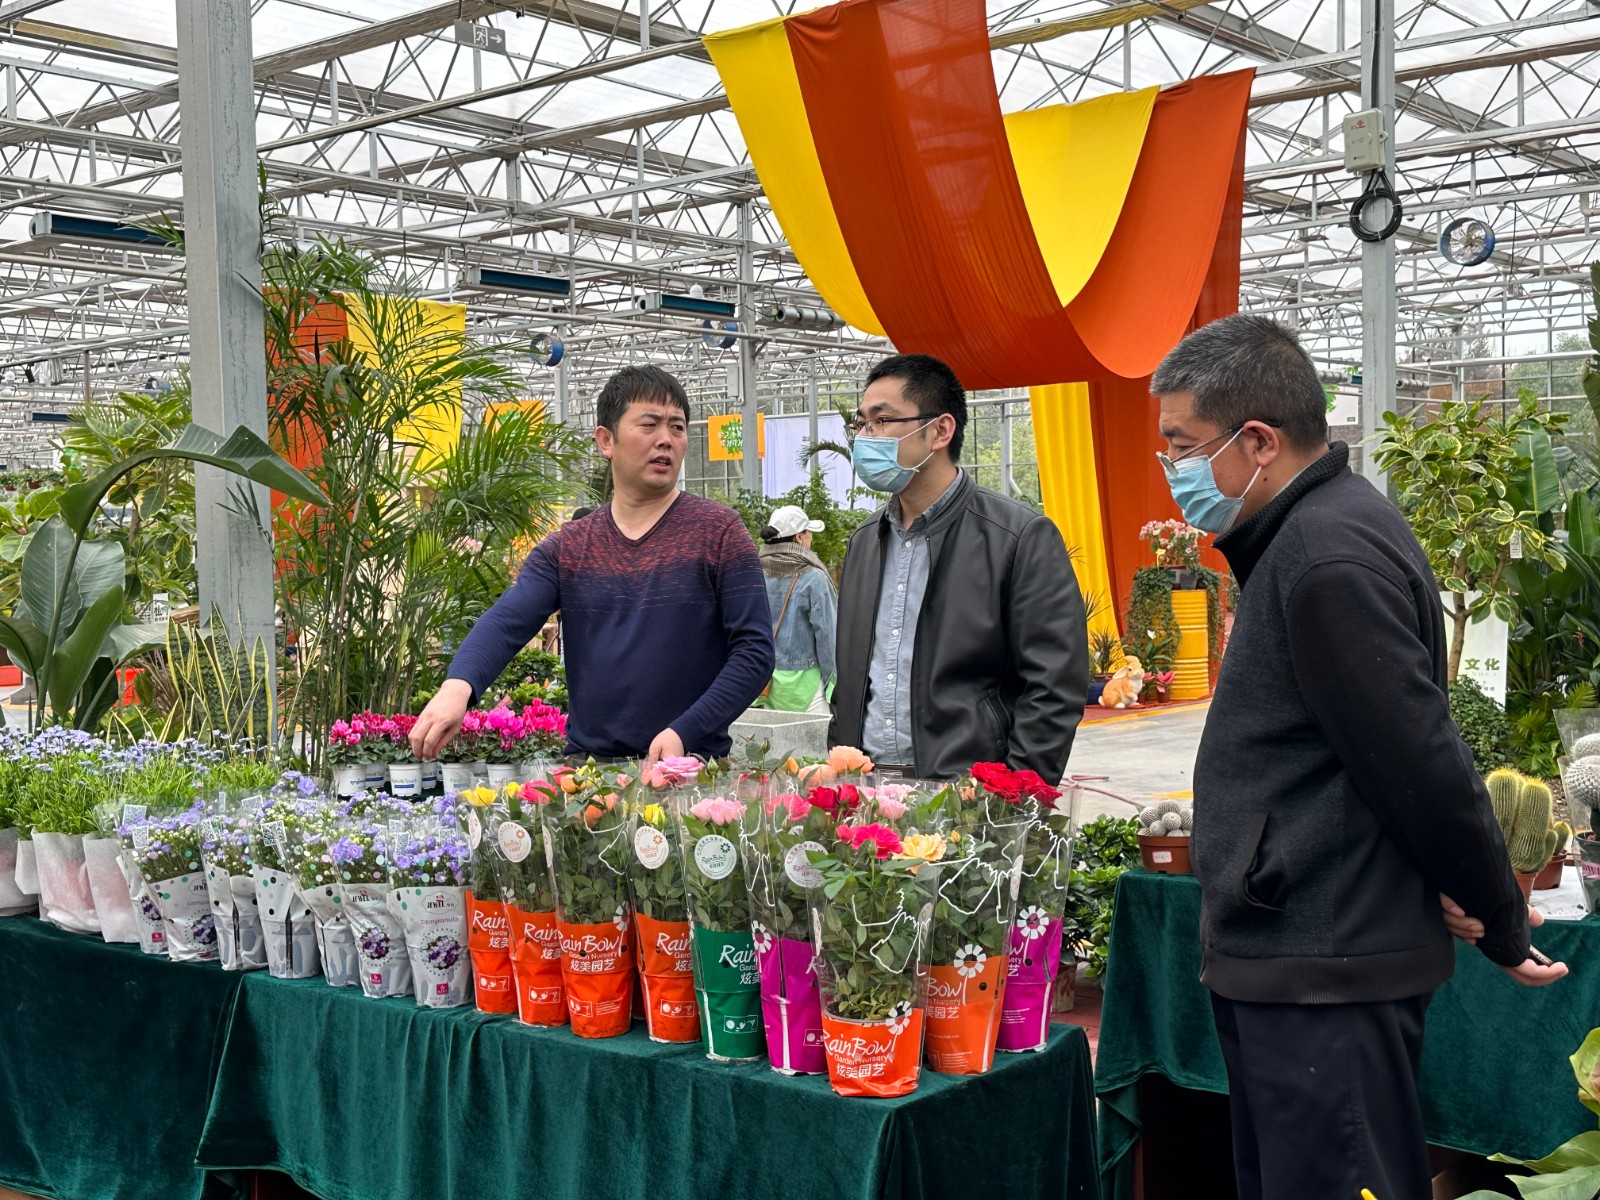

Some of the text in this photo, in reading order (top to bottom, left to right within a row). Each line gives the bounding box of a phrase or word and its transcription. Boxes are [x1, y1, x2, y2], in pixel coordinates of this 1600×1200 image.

[1464, 658, 1500, 671] 文化
[427, 900, 445, 909] JEWEL
[420, 916, 460, 926] campanula
[591, 951, 618, 960] Nursery
[570, 958, 616, 973] 炫美园艺
[834, 1053, 890, 1066] Garden Nursery
[836, 1063, 886, 1079] 炫美园艺
